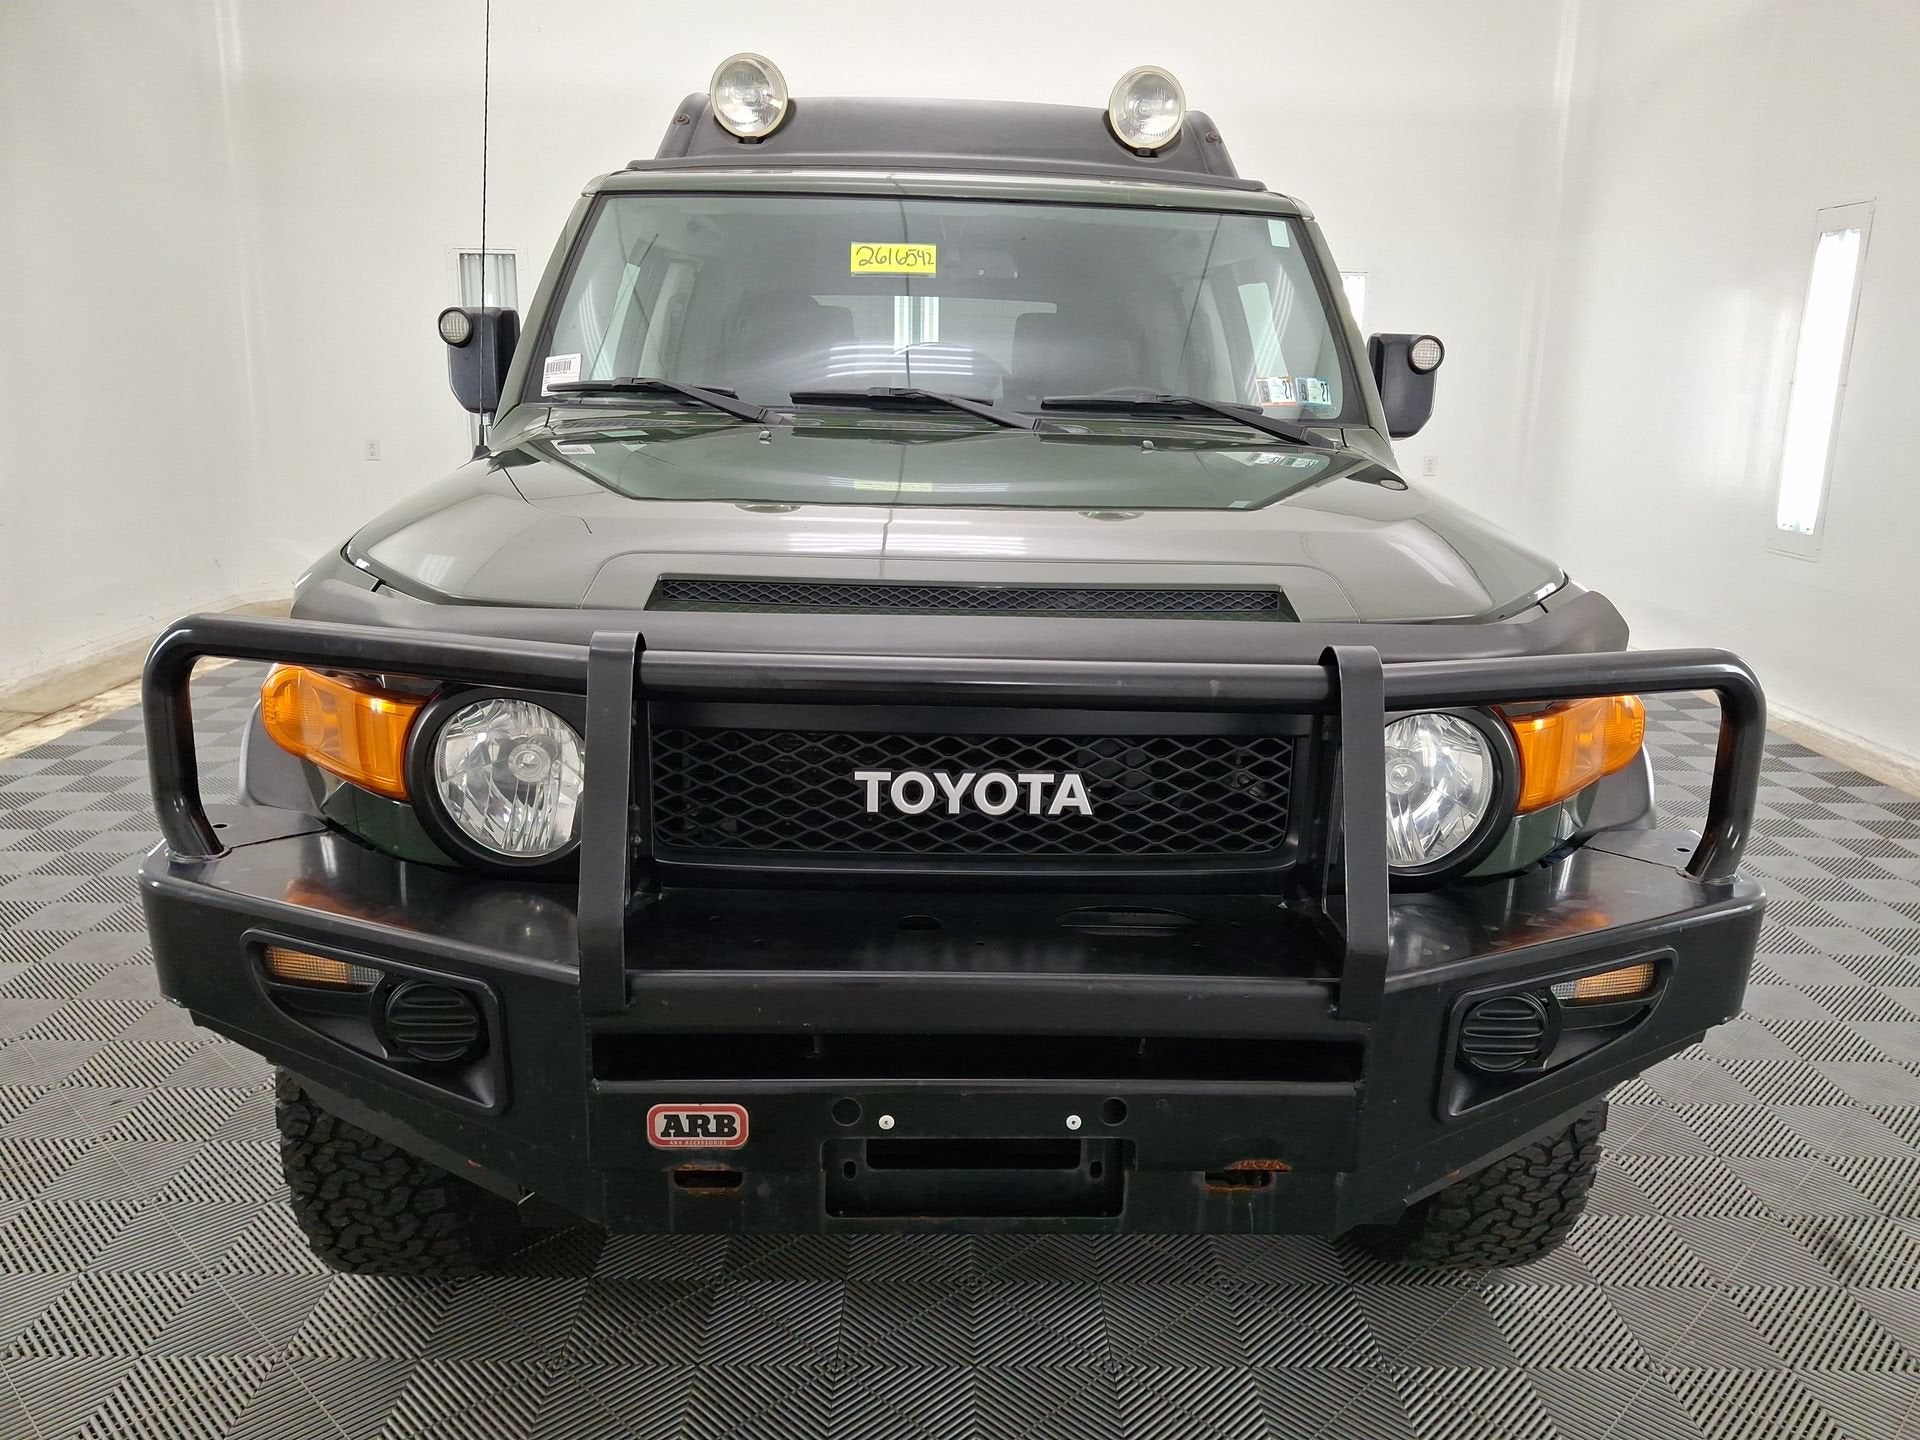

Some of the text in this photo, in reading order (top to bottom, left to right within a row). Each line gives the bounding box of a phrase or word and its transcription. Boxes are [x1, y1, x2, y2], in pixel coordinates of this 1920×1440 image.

[856, 246, 934, 267] 2616542
[854, 771, 1093, 816] TOYOTA
[661, 1114, 738, 1138] ARB
